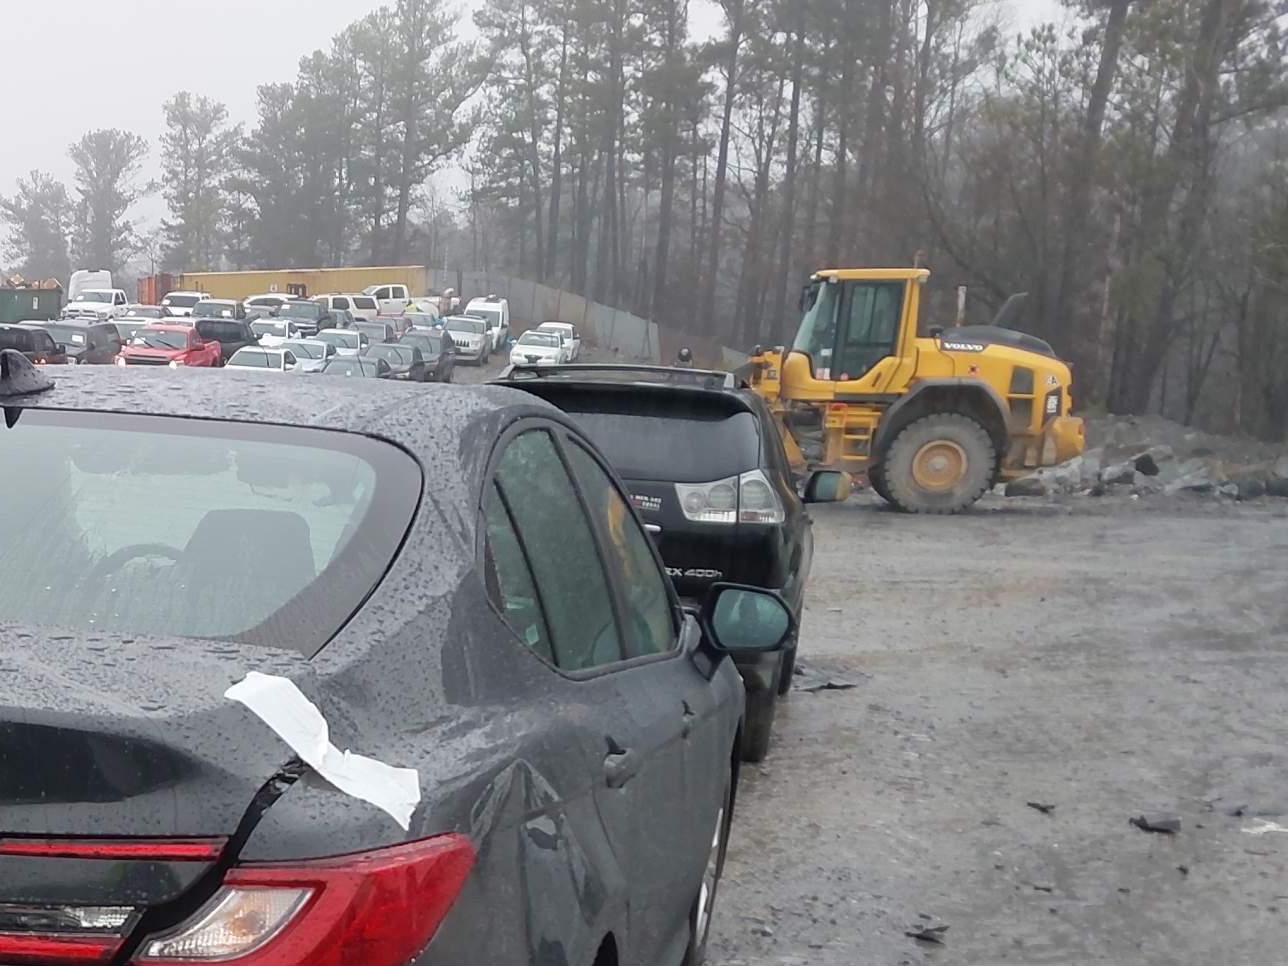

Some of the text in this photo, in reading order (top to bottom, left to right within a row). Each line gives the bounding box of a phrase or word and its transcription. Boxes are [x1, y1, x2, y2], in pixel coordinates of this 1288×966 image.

[944, 342, 984, 351] VOLVO
[664, 567, 723, 578] RX 400h
